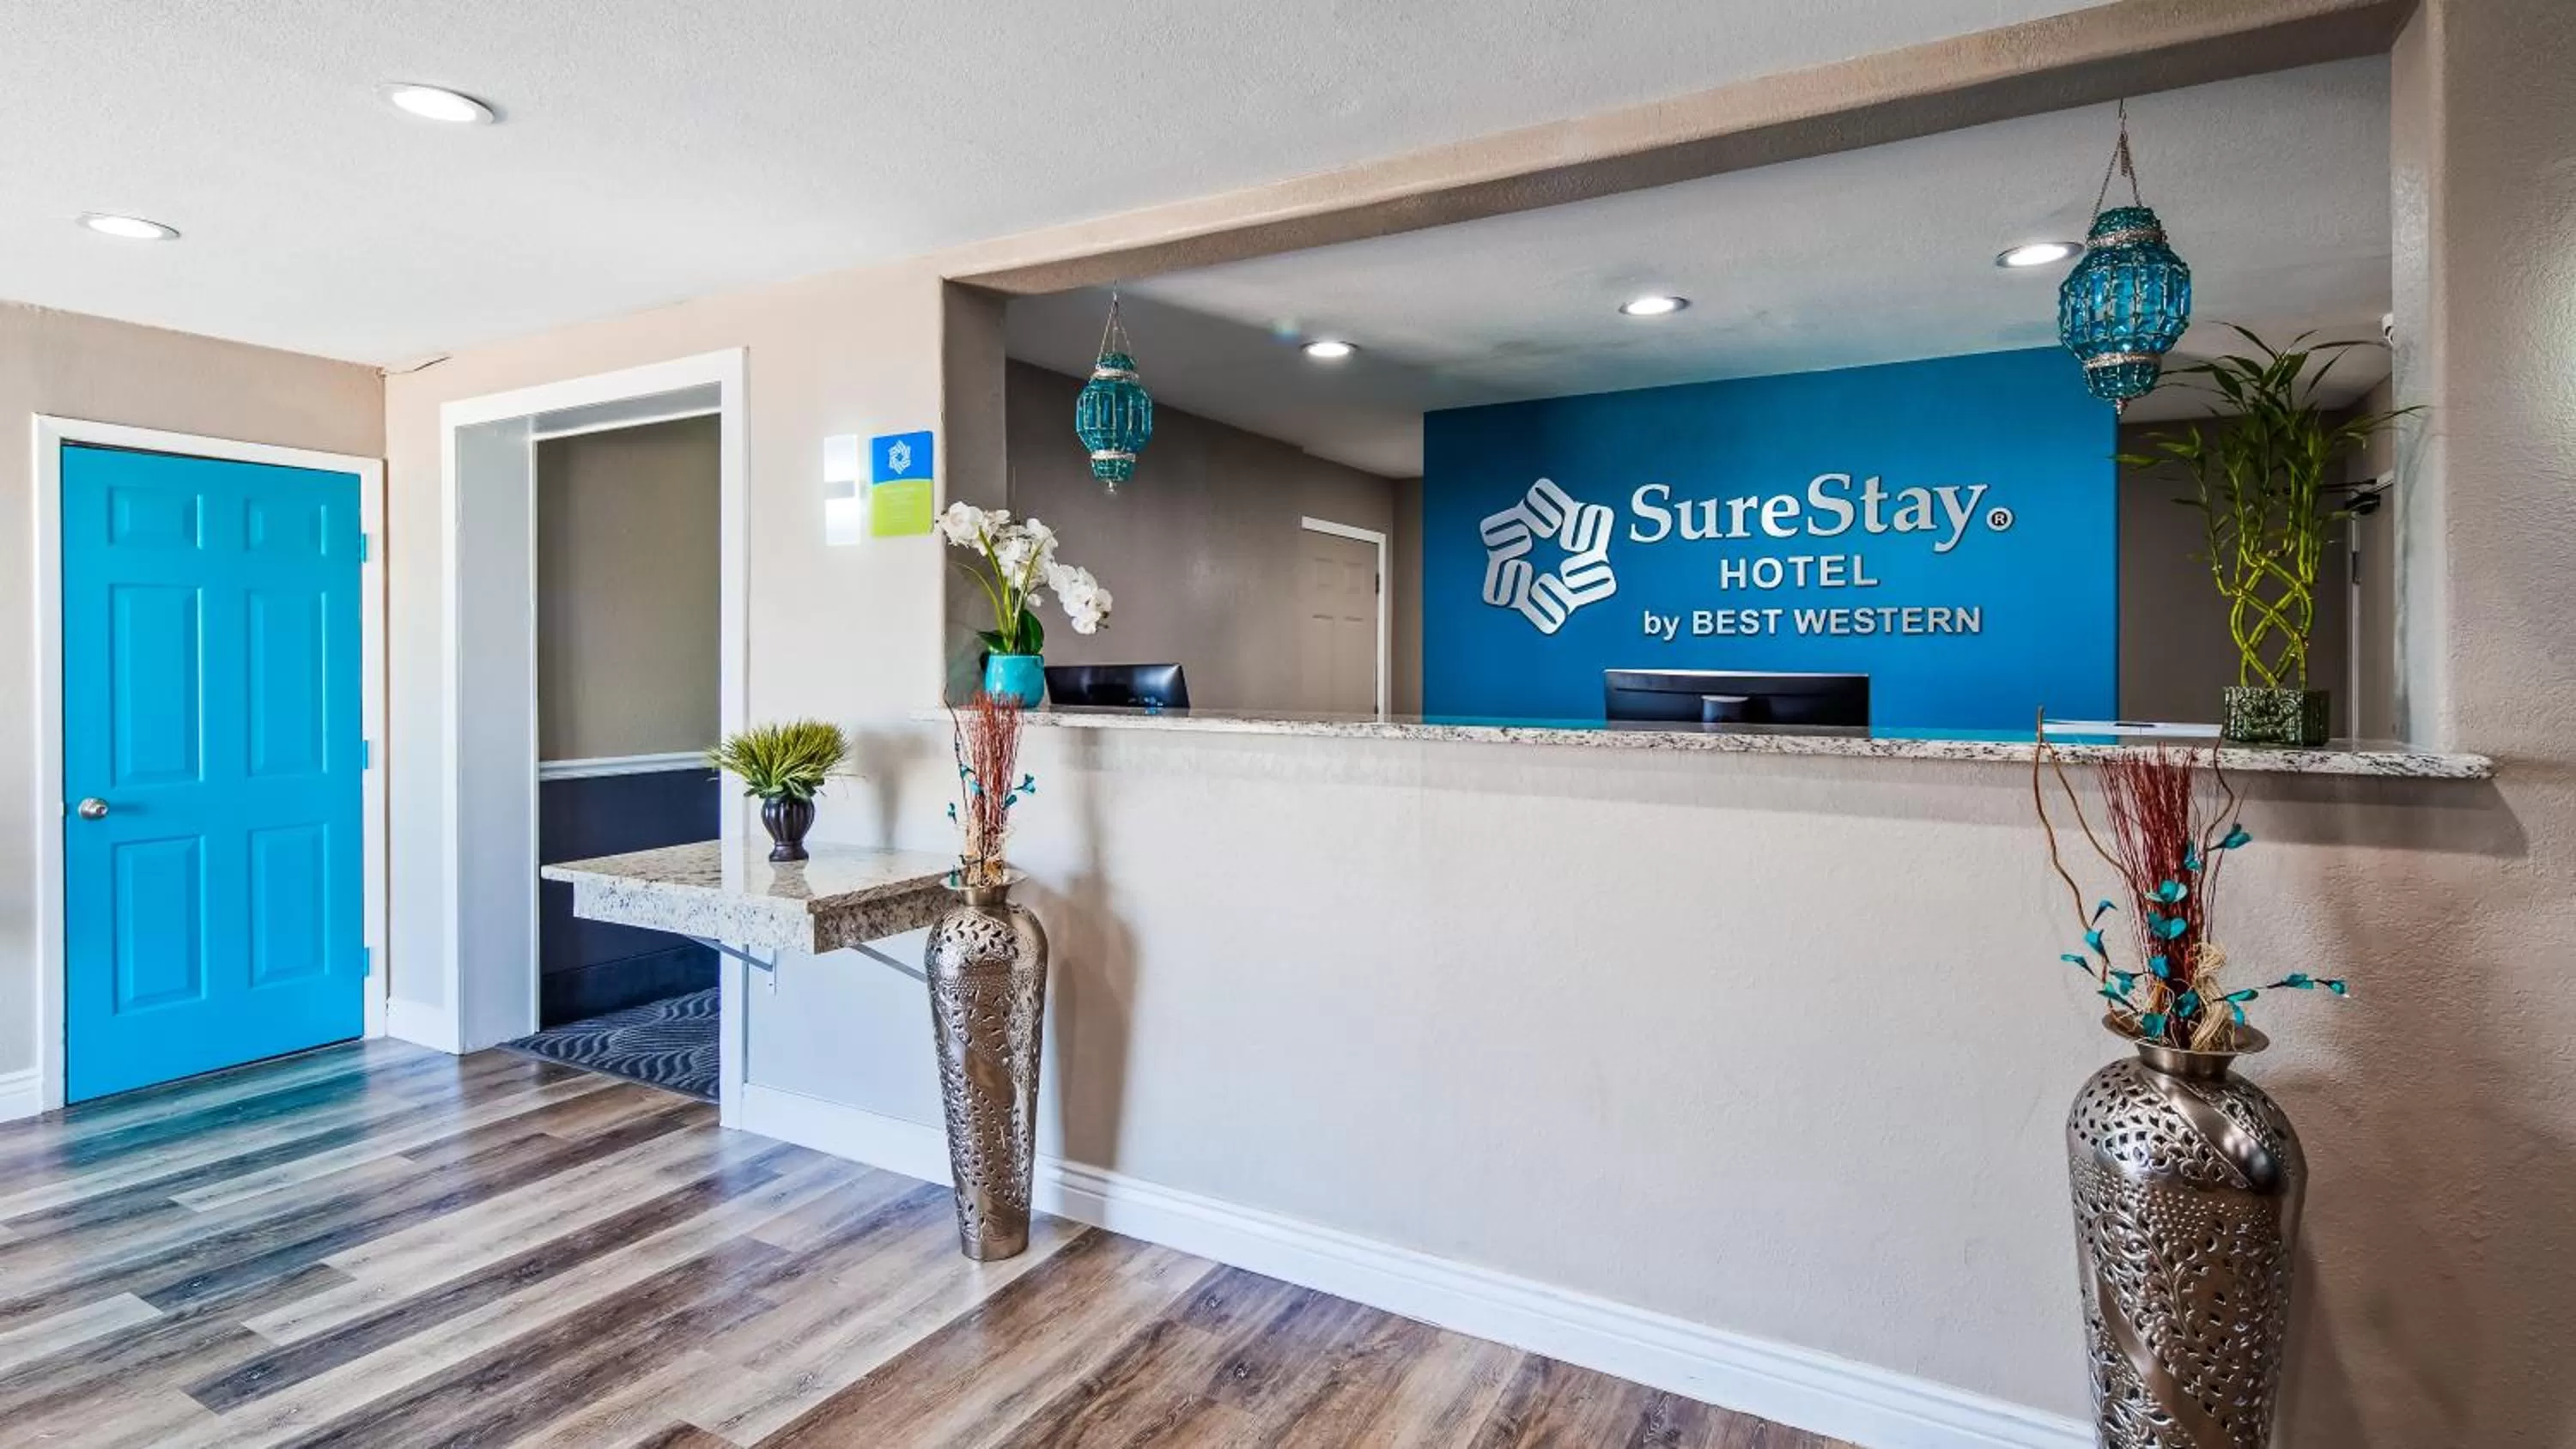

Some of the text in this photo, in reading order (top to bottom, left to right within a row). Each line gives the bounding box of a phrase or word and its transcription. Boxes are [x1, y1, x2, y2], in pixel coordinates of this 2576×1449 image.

[1720, 555, 1878, 589] HOTEL
[1643, 607, 1982, 640] by BEST WESTERN
